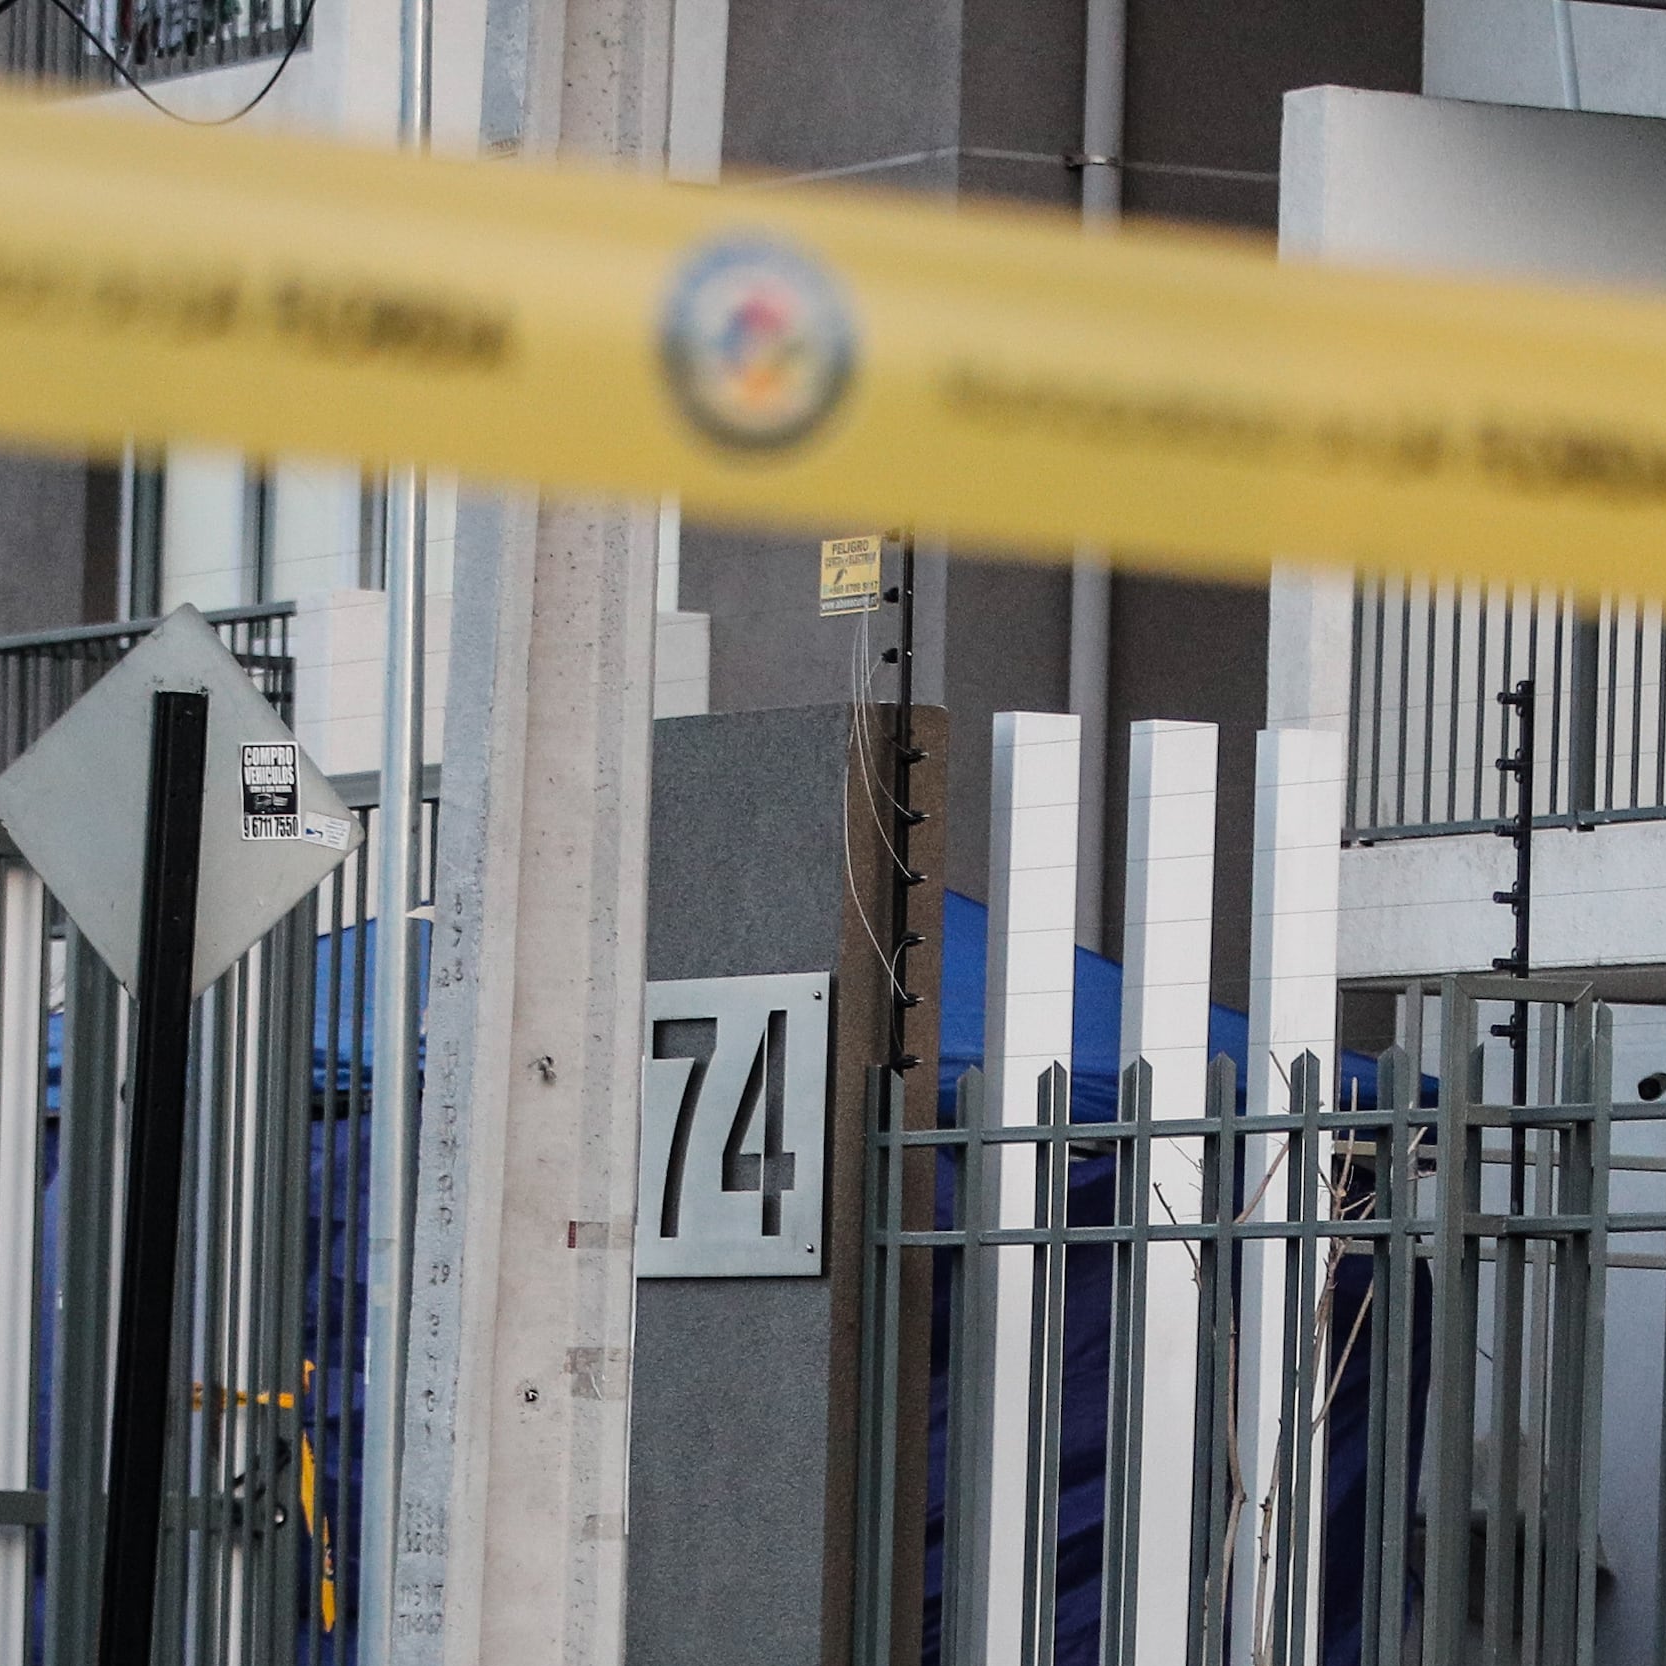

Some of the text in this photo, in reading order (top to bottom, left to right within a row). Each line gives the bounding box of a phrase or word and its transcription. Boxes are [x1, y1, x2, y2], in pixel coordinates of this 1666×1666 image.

[244, 746, 294, 766] COMPRO
[244, 766, 295, 785] VEHICULOS
[652, 1009, 796, 1239] 74
